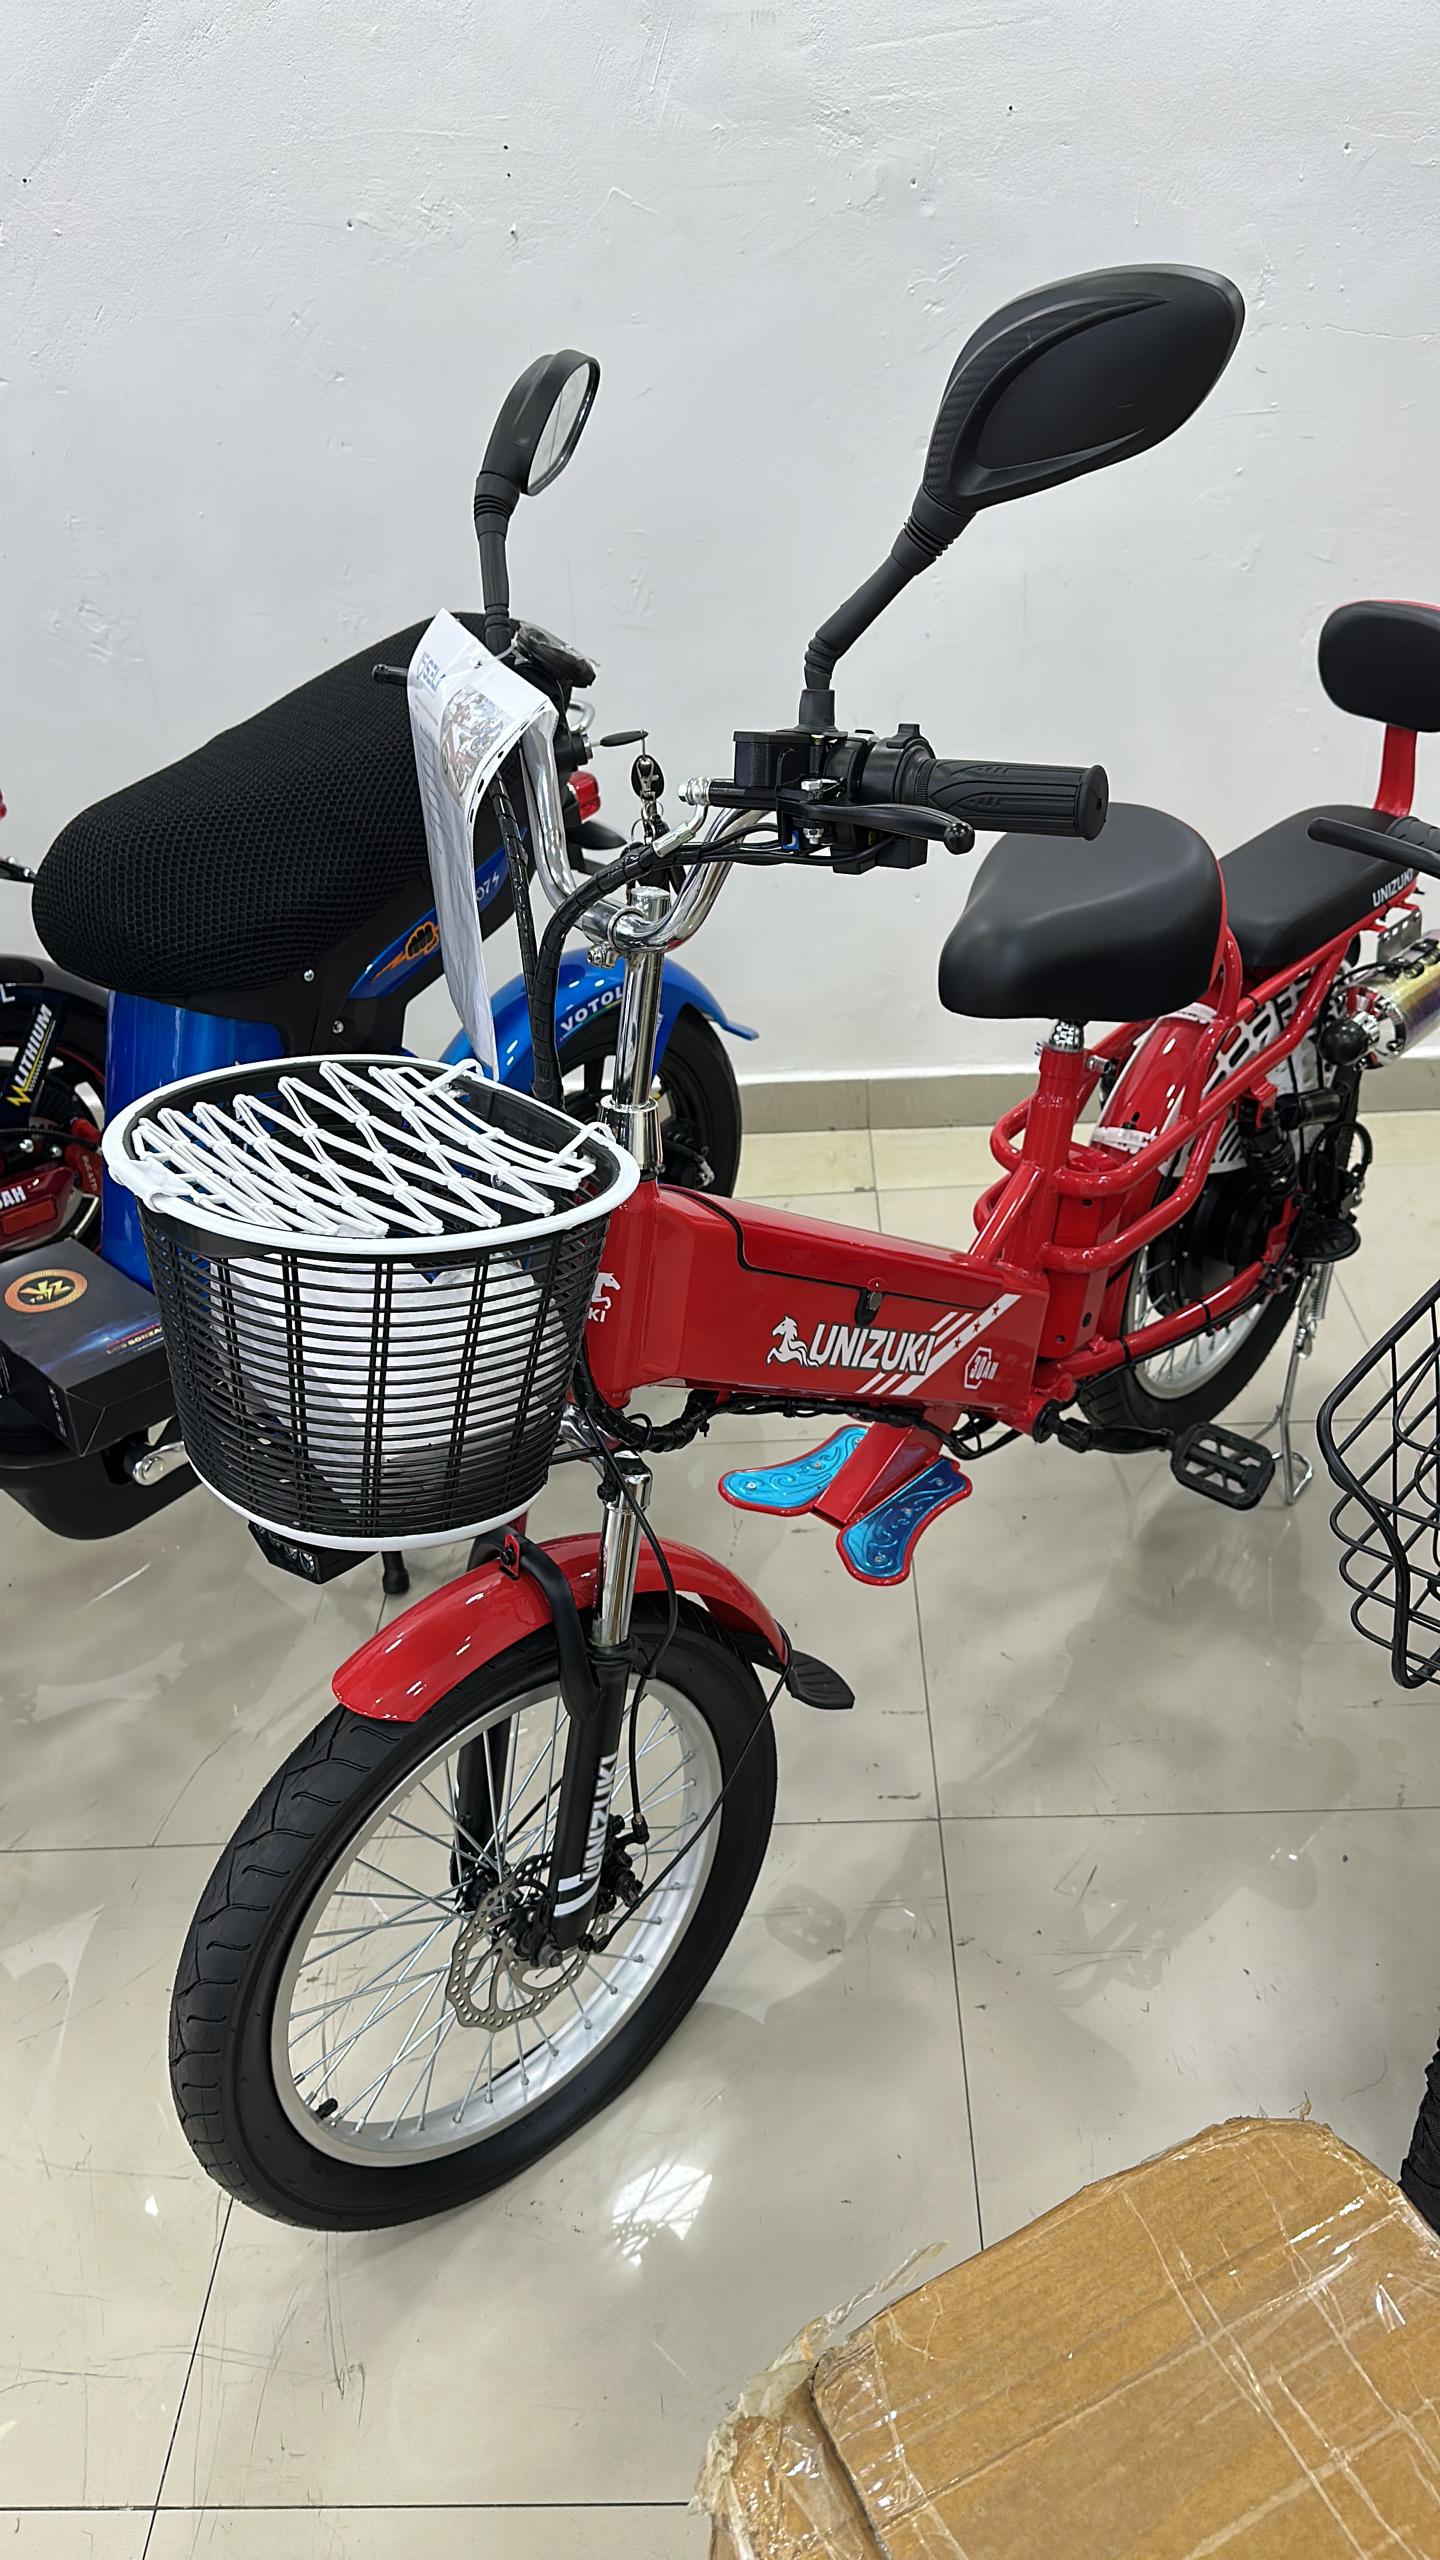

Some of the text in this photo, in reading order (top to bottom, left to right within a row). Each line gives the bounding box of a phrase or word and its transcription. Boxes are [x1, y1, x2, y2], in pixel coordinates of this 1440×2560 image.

[1372, 867, 1413, 907] UNIZUKI
[560, 985, 625, 1032] VOTOL
[14, 1003, 53, 1088] LITHIUM
[587, 1307, 606, 1323] KI
[808, 1323, 937, 1374] UNIZUKI
[969, 1354, 999, 1380] 30AH
[581, 1750, 618, 1881] UNIZUKI
